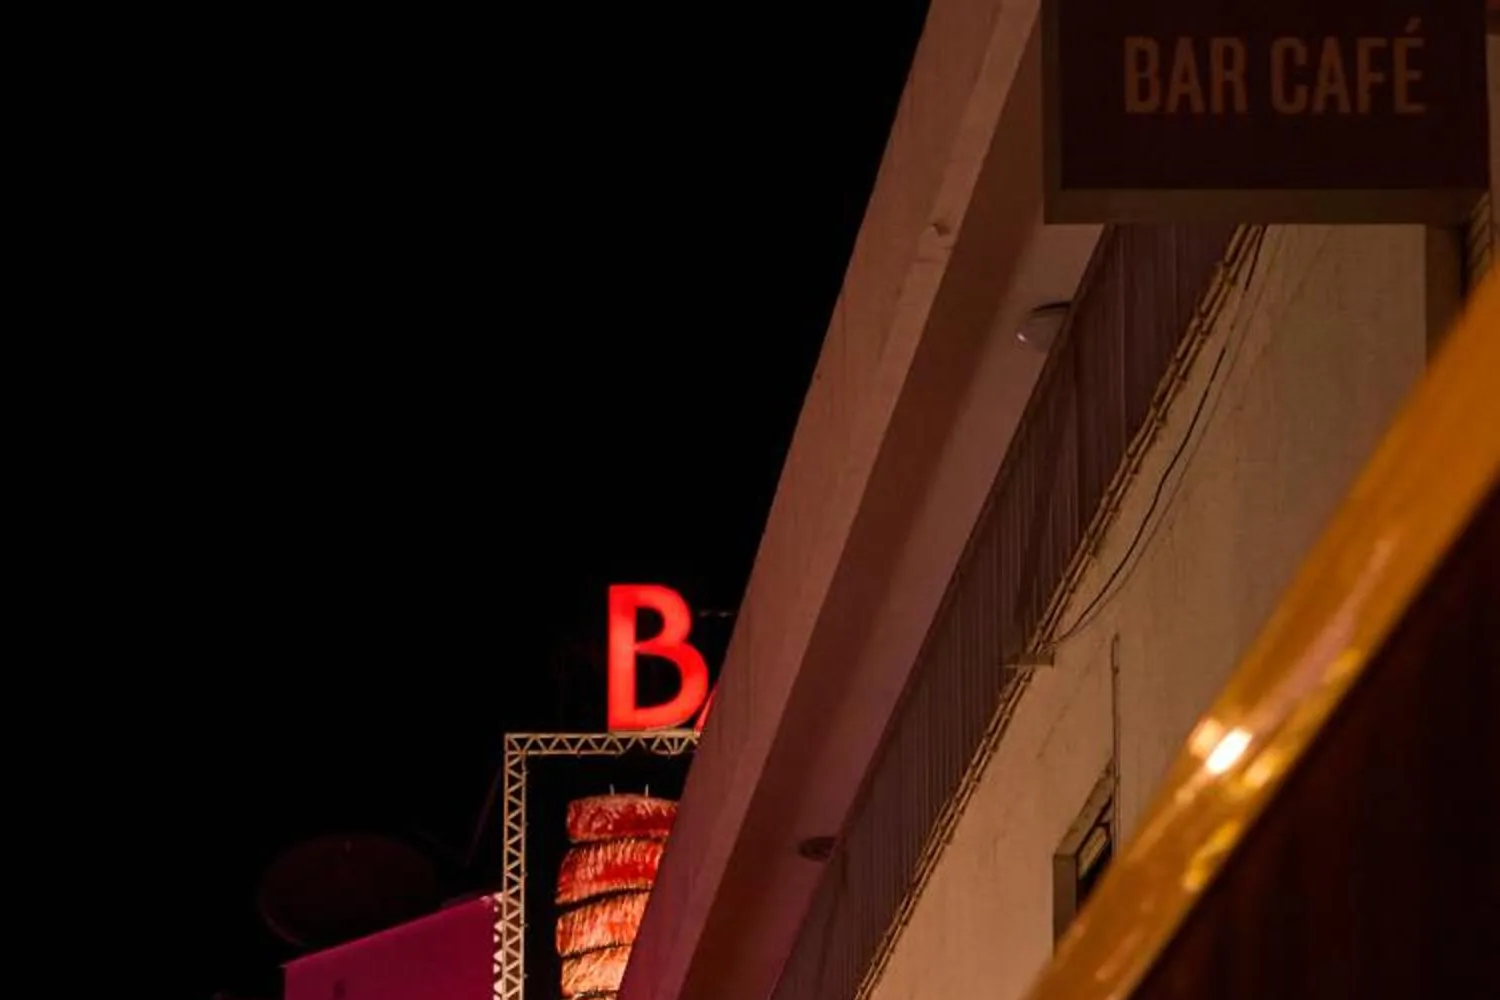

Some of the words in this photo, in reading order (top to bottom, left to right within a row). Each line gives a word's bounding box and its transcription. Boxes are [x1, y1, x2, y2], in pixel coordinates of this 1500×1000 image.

[1123, 36, 1249, 115] BAR
[1269, 16, 1427, 115] CAFÉ
[608, 583, 717, 733] B
